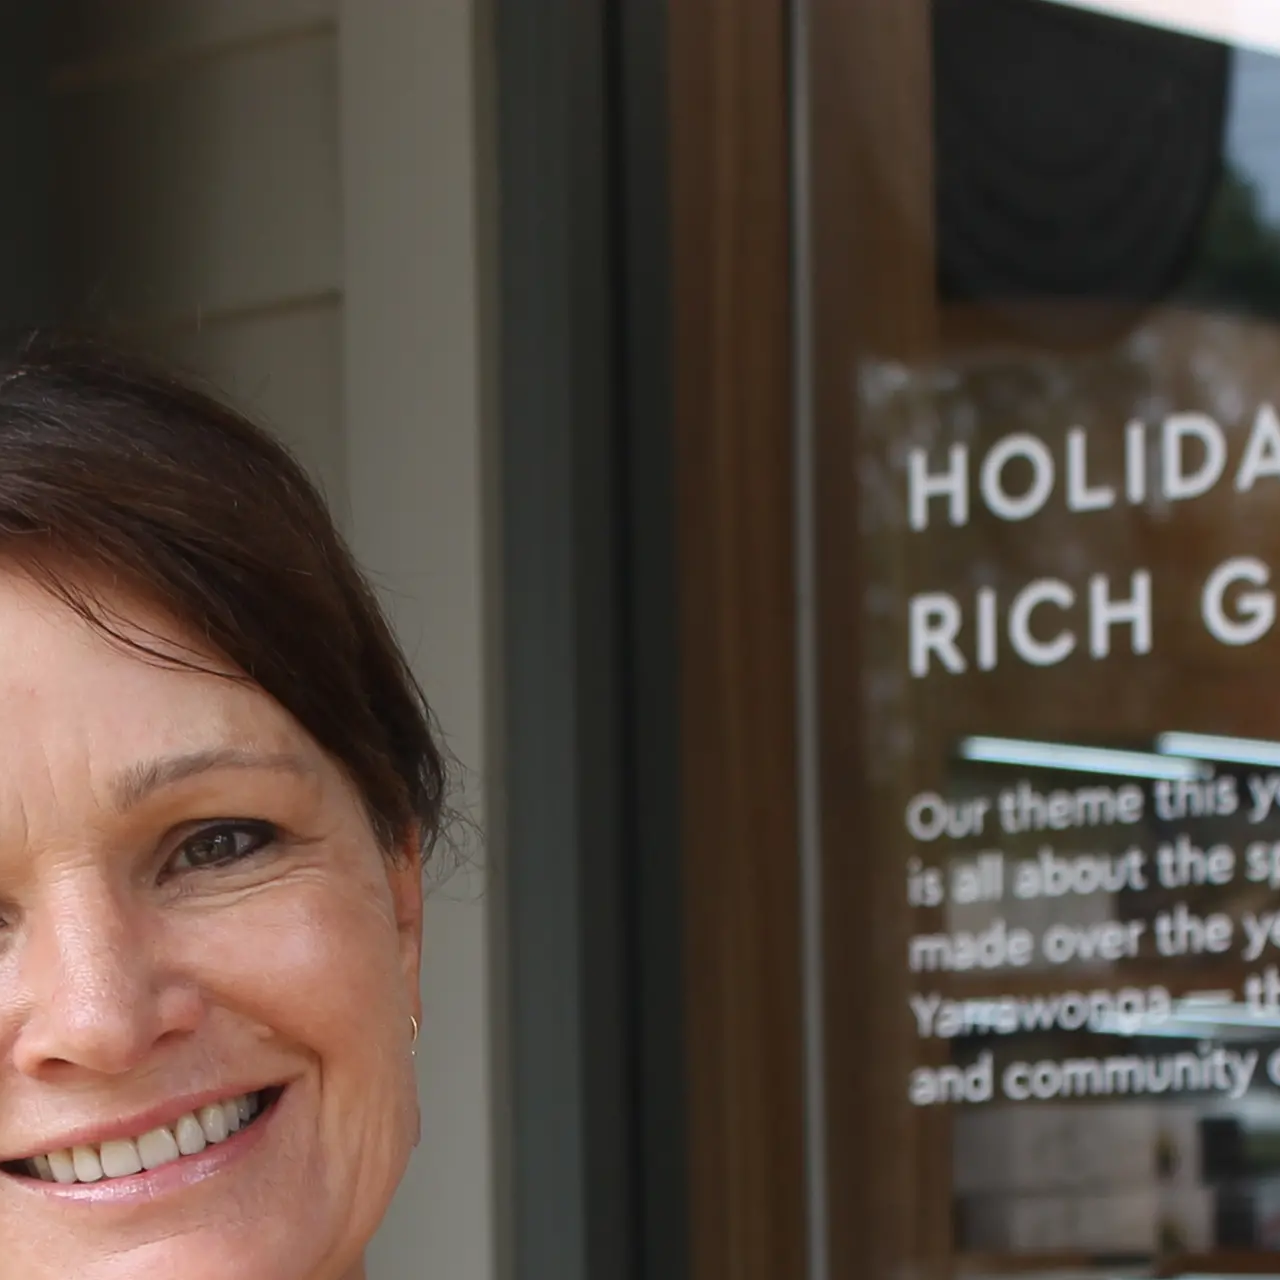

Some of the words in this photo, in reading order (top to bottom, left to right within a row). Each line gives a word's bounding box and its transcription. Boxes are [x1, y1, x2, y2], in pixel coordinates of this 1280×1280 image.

[908, 569, 1153, 678] RICH
[905, 792, 988, 842] Our
[999, 781, 1144, 833] theme
[1153, 764, 1238, 821] this
[907, 859, 943, 907] is
[951, 852, 1003, 904] all
[1014, 846, 1147, 898] about
[1156, 835, 1236, 889] the
[907, 923, 1033, 973] made
[1042, 921, 1146, 966] over
[1155, 904, 1233, 954] the
[909, 985, 1174, 1038] Yarrawonga
[909, 1052, 995, 1105] and
[1002, 1041, 1259, 1100] community
